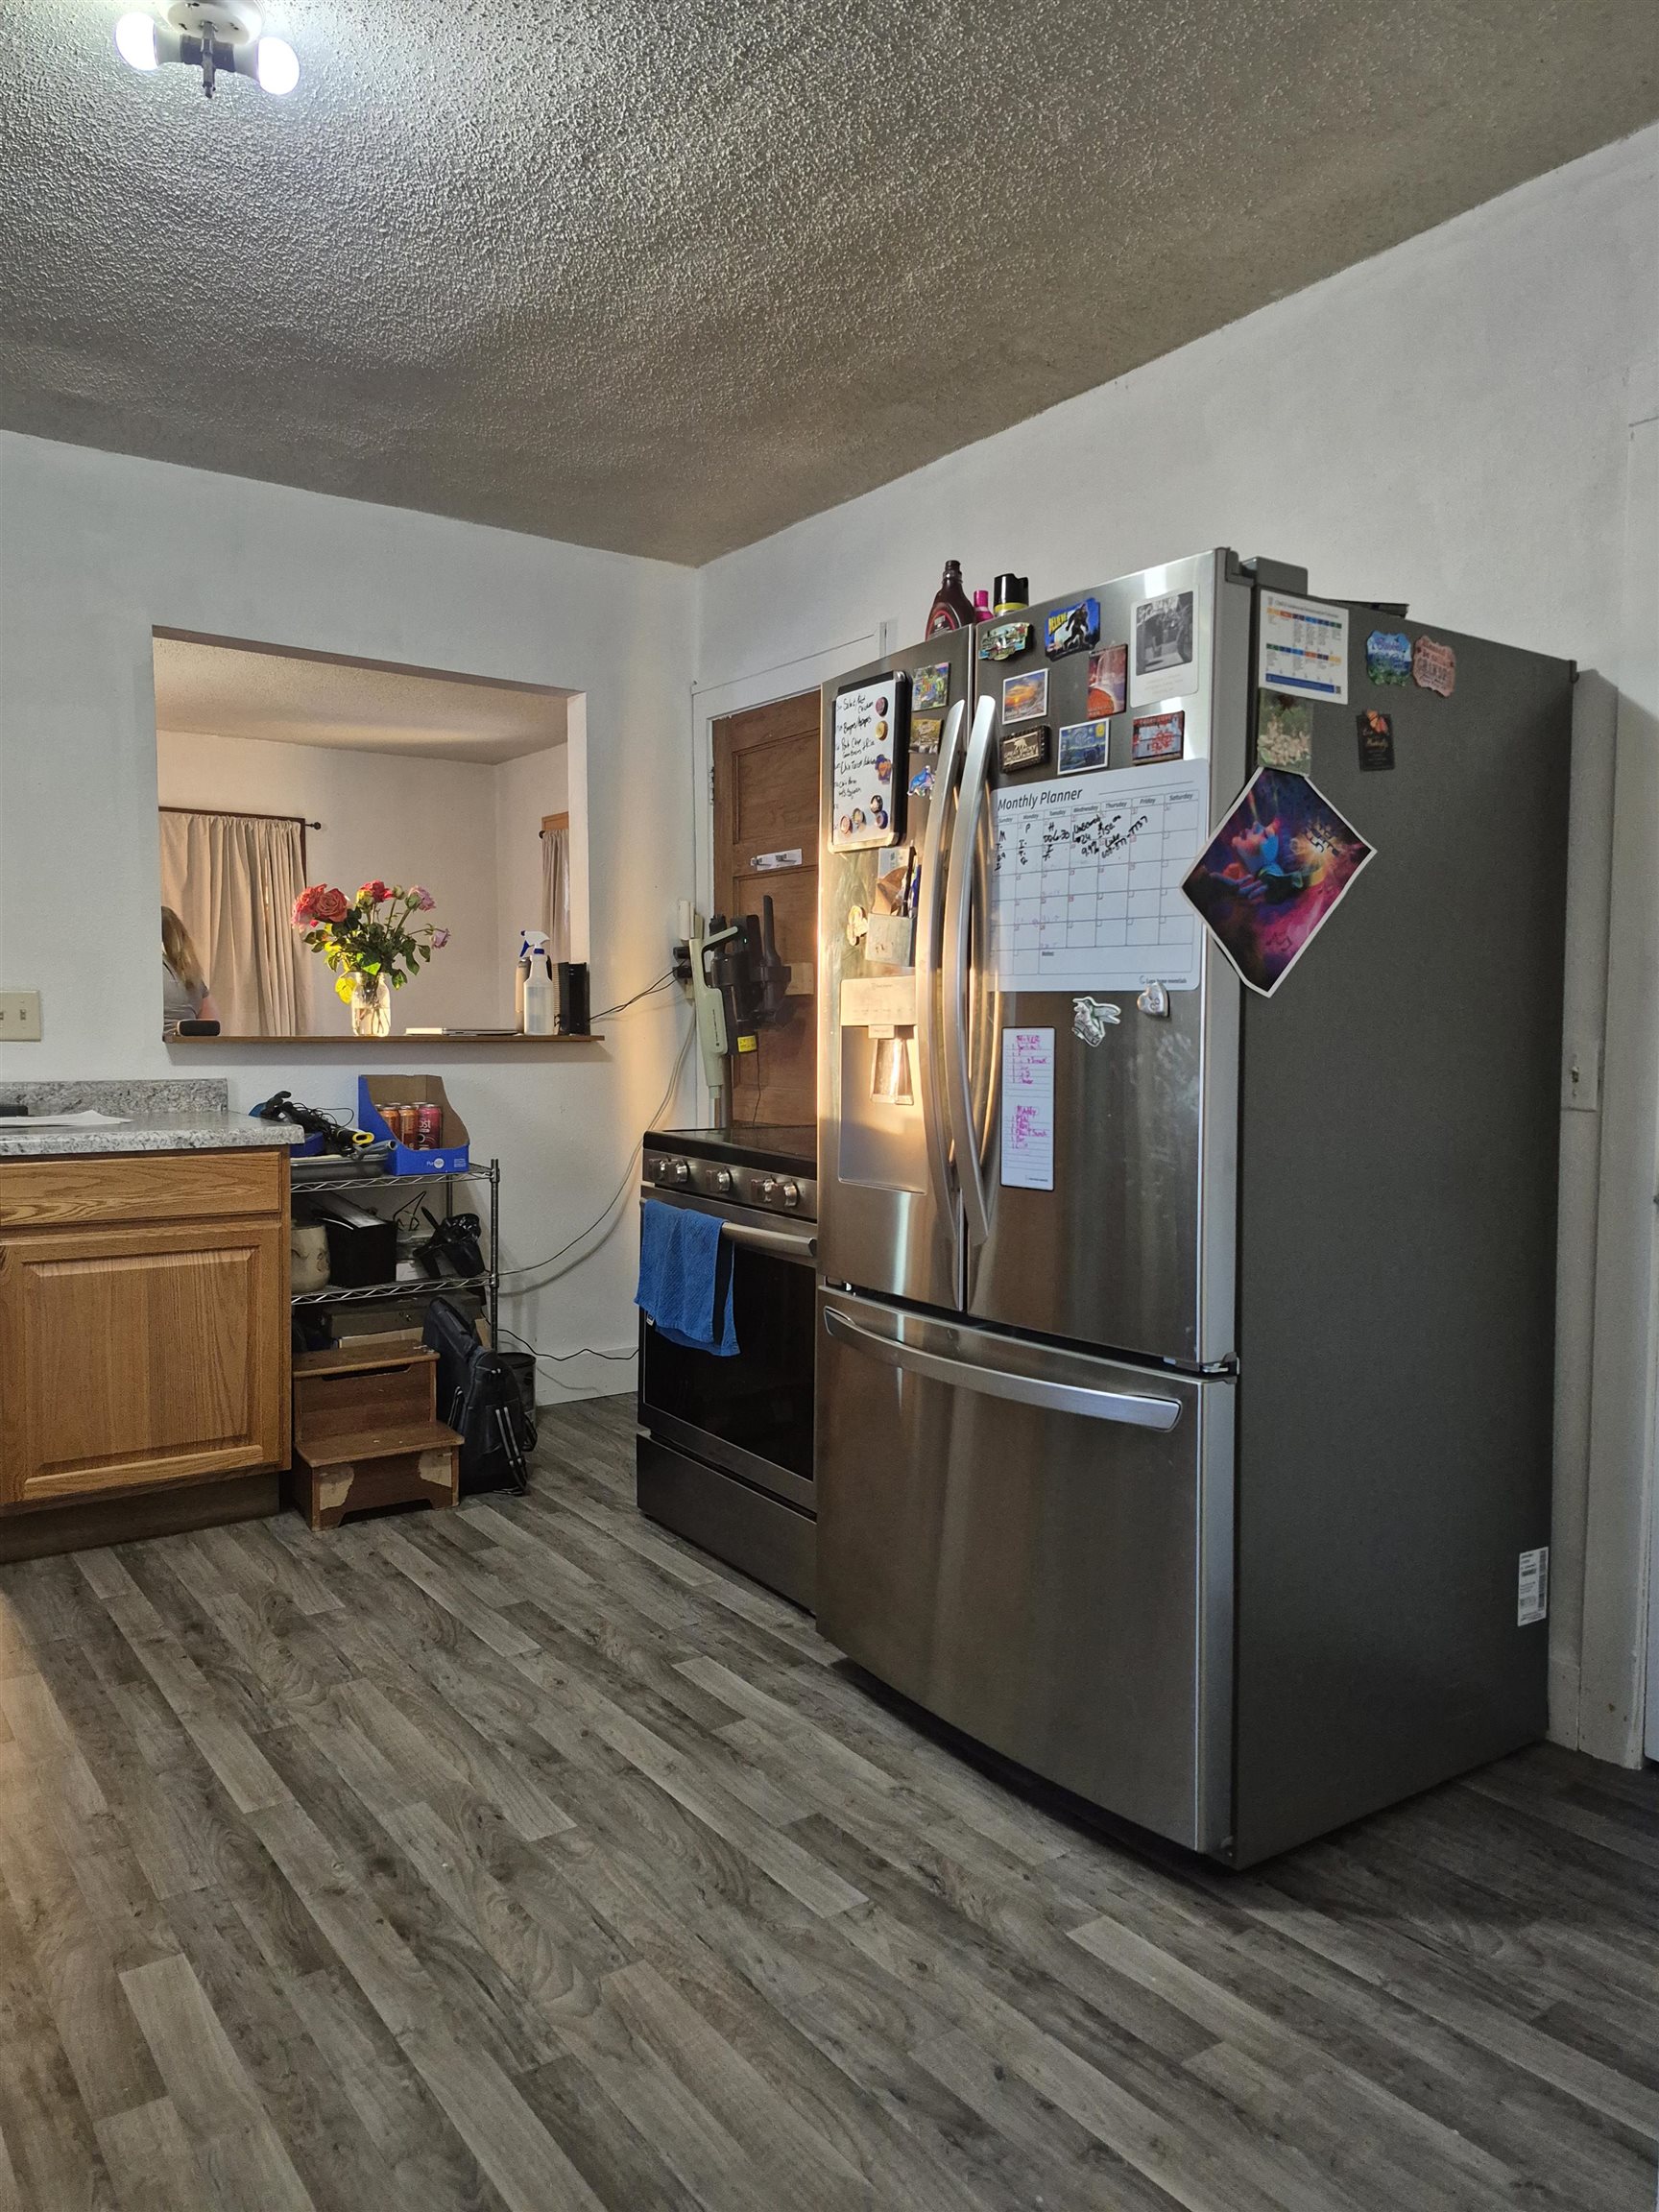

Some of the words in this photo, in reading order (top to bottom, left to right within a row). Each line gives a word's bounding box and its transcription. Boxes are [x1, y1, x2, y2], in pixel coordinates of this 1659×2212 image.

[998, 793, 1038, 810] Monthly
[1040, 789, 1083, 805] Planner
[1169, 793, 1193, 802] Saturday
